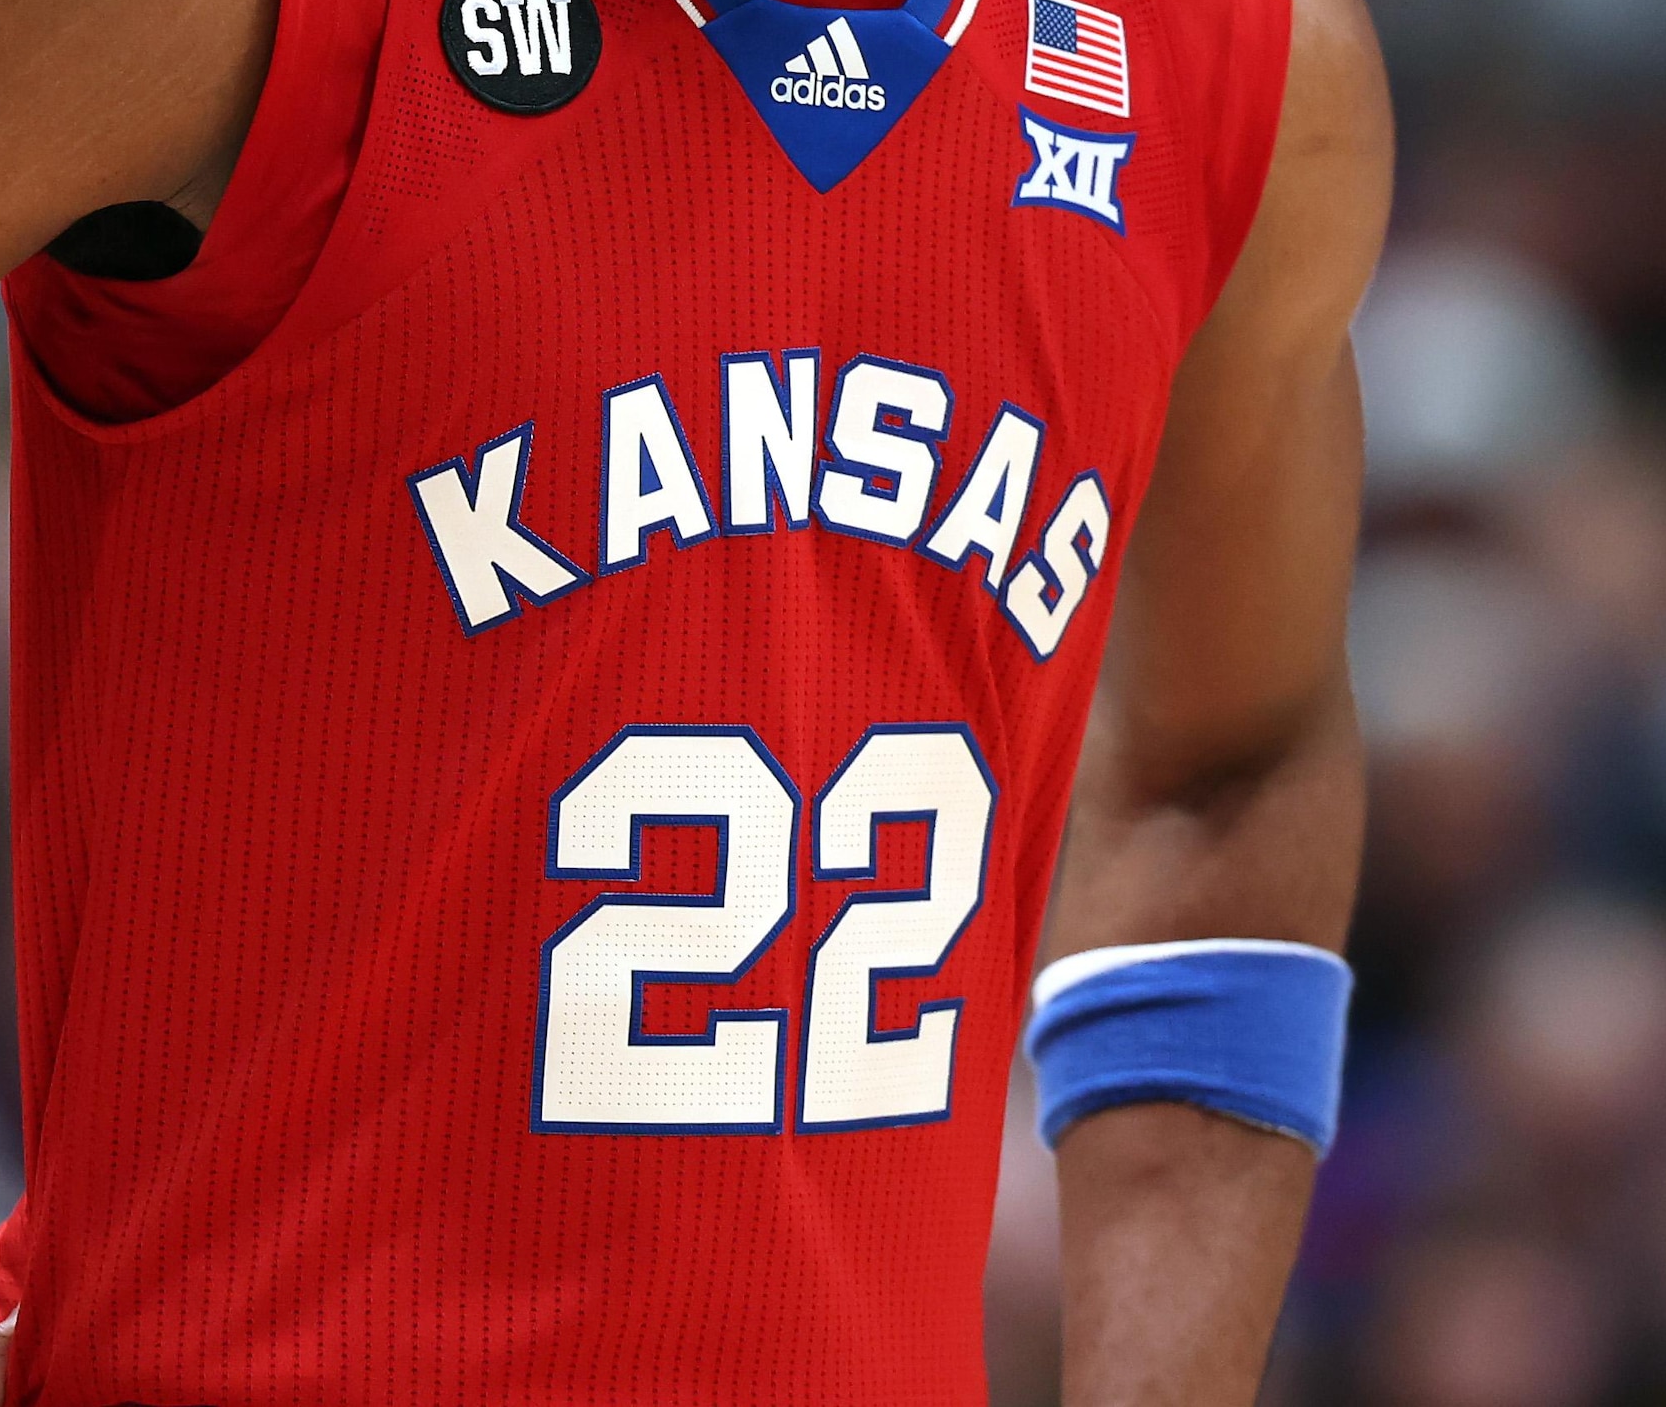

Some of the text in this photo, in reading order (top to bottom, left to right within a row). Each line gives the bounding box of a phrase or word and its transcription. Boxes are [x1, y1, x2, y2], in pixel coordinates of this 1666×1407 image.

[770, 73, 886, 111] adidas
[406, 346, 1112, 663] KANSAS
[530, 721, 1000, 1135] 22
